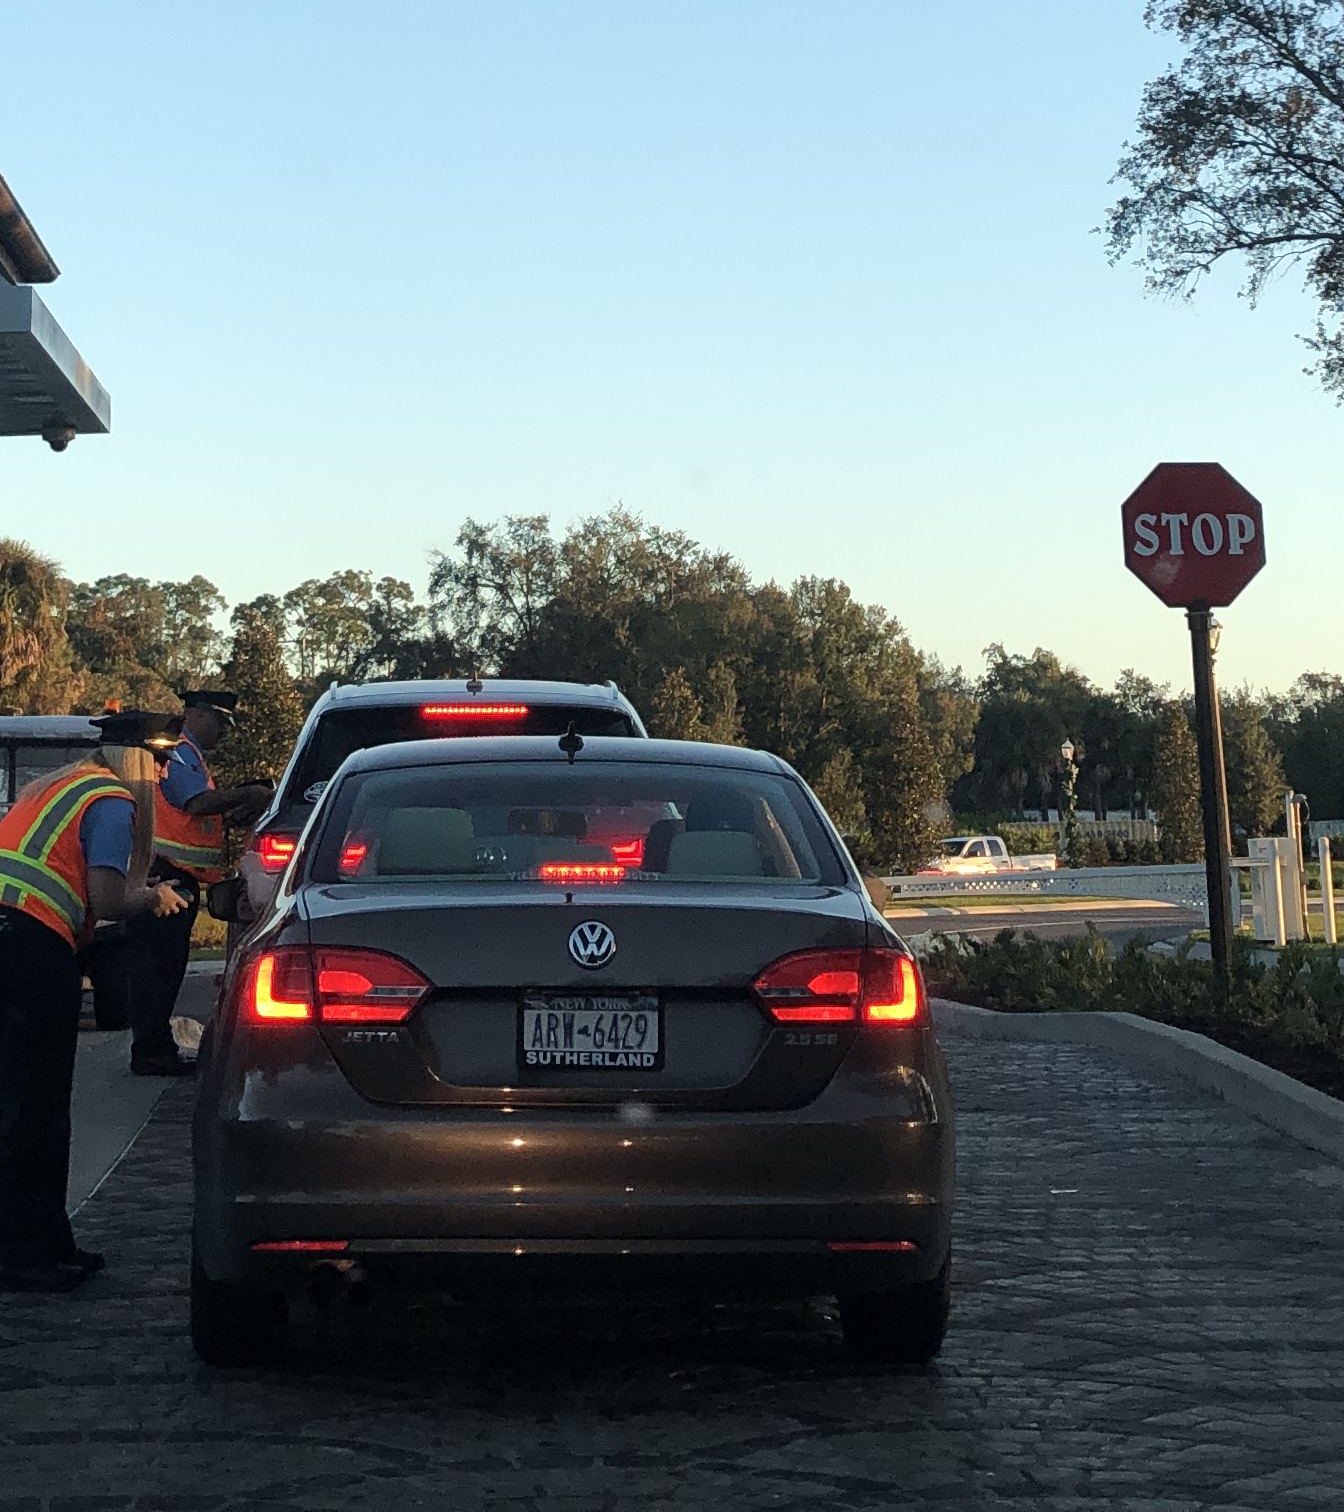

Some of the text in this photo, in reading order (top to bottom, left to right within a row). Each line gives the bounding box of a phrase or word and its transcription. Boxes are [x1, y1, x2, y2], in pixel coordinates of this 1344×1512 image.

[1133, 512, 1256, 556] STOP
[553, 996, 586, 1010] NEW
[341, 1031, 400, 1043] JETTA
[525, 1051, 655, 1067] SUTHERLAND
